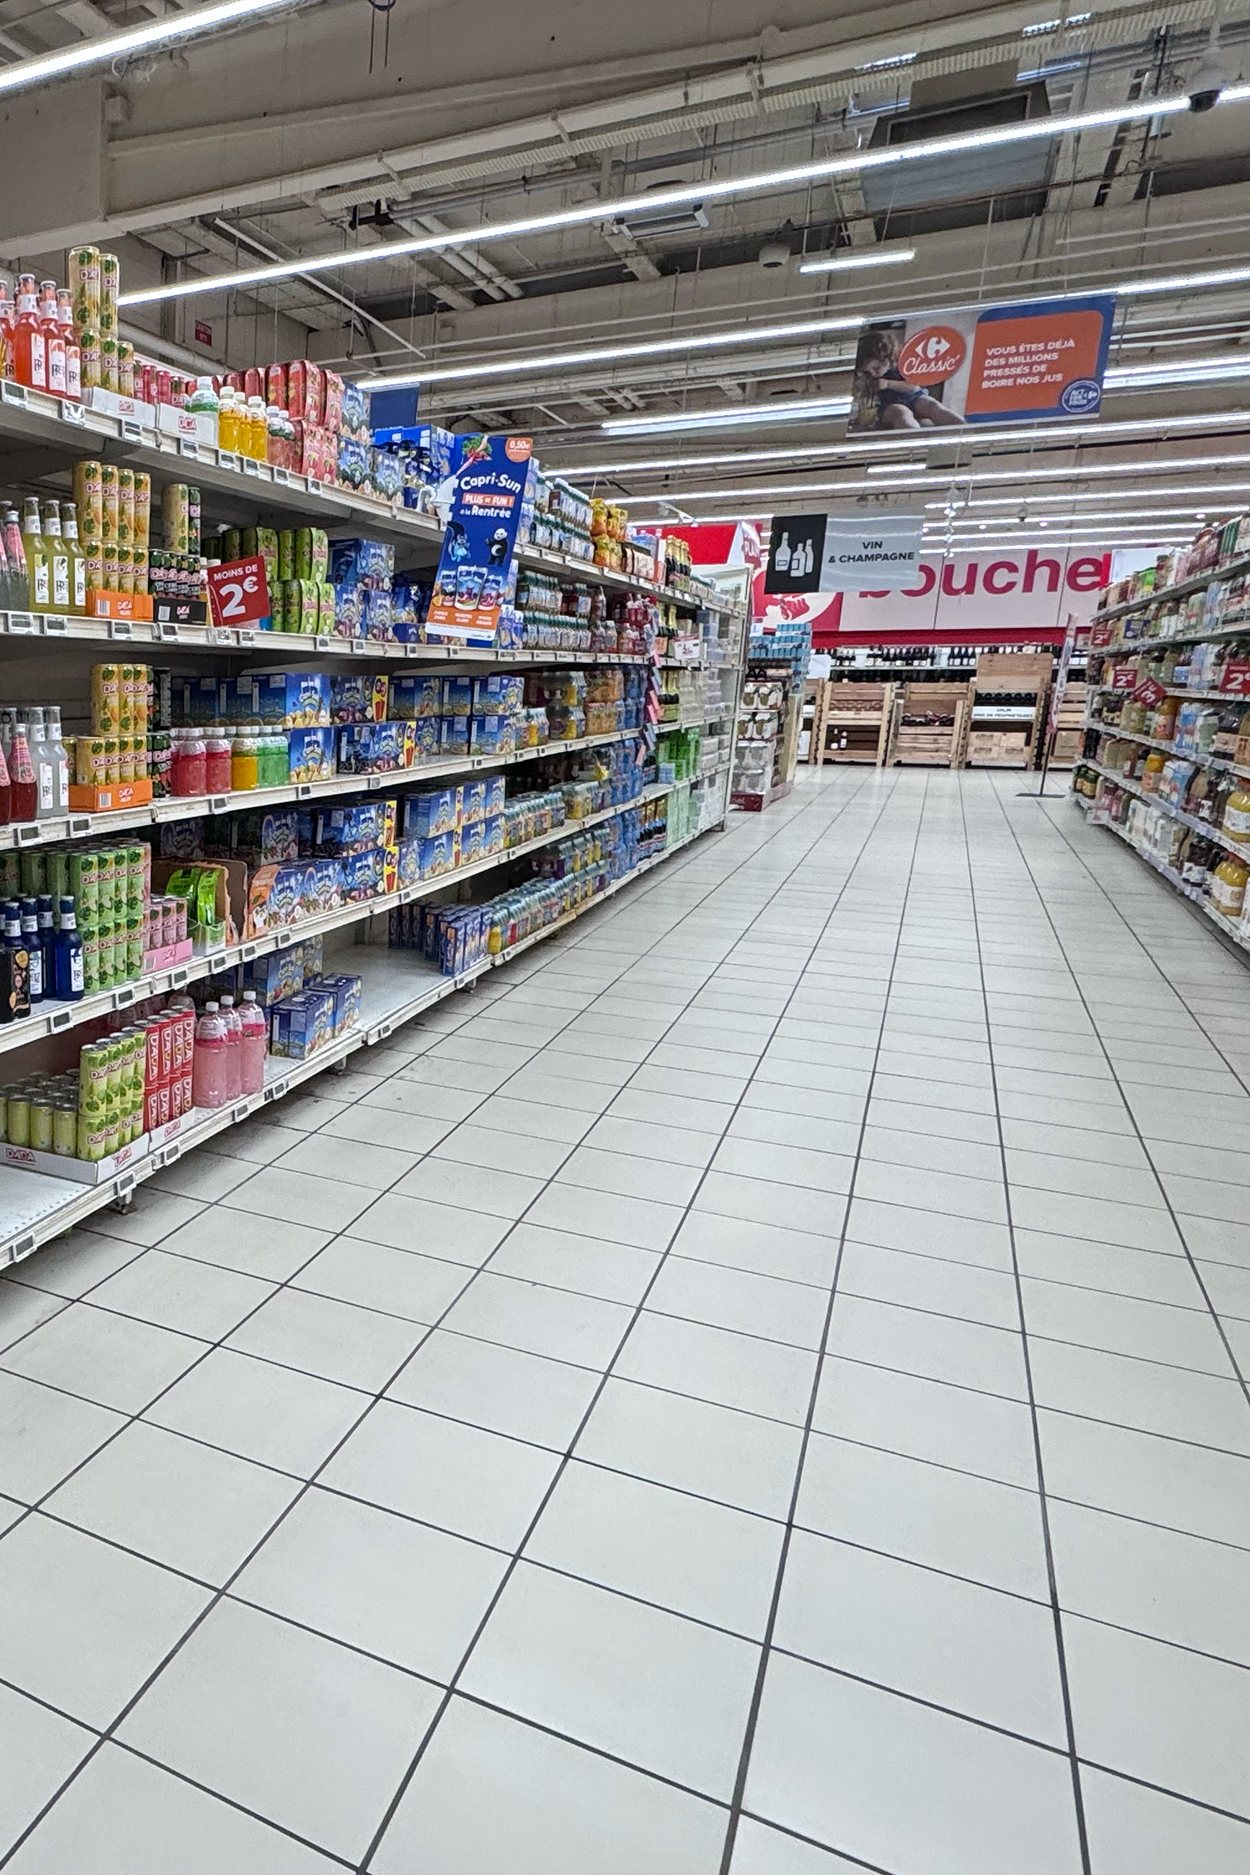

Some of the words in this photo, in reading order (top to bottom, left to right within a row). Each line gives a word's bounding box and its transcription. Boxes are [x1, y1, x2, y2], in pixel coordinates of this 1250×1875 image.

[80, 269, 99, 281] DA
[986, 346, 1016, 356] VOUS
[1047, 338, 1075, 350] DÉJÀ
[985, 358, 1006, 367] DES
[1008, 353, 1058, 364] MILLIONS
[983, 365, 1030, 378] PRESSÉS
[1033, 364, 1047, 373] DE
[982, 379, 1014, 389] BOIRE
[1016, 375, 1040, 385] NOS
[1041, 374, 1063, 383] JUS
[460, 472, 522, 493] Capri-Sun
[465, 494, 483, 504] PLUS
[491, 496, 507, 505] FUN
[471, 505, 511, 518] Rentrée
[862, 541, 883, 549] VIN
[839, 552, 915, 563] CHAMPAGNE
[214, 567, 244, 581] MOINS
[245, 564, 258, 575] DE
[859, 549, 1102, 599] ouche
[219, 576, 259, 618] 2€
[6, 1148, 36, 1162] DADA
